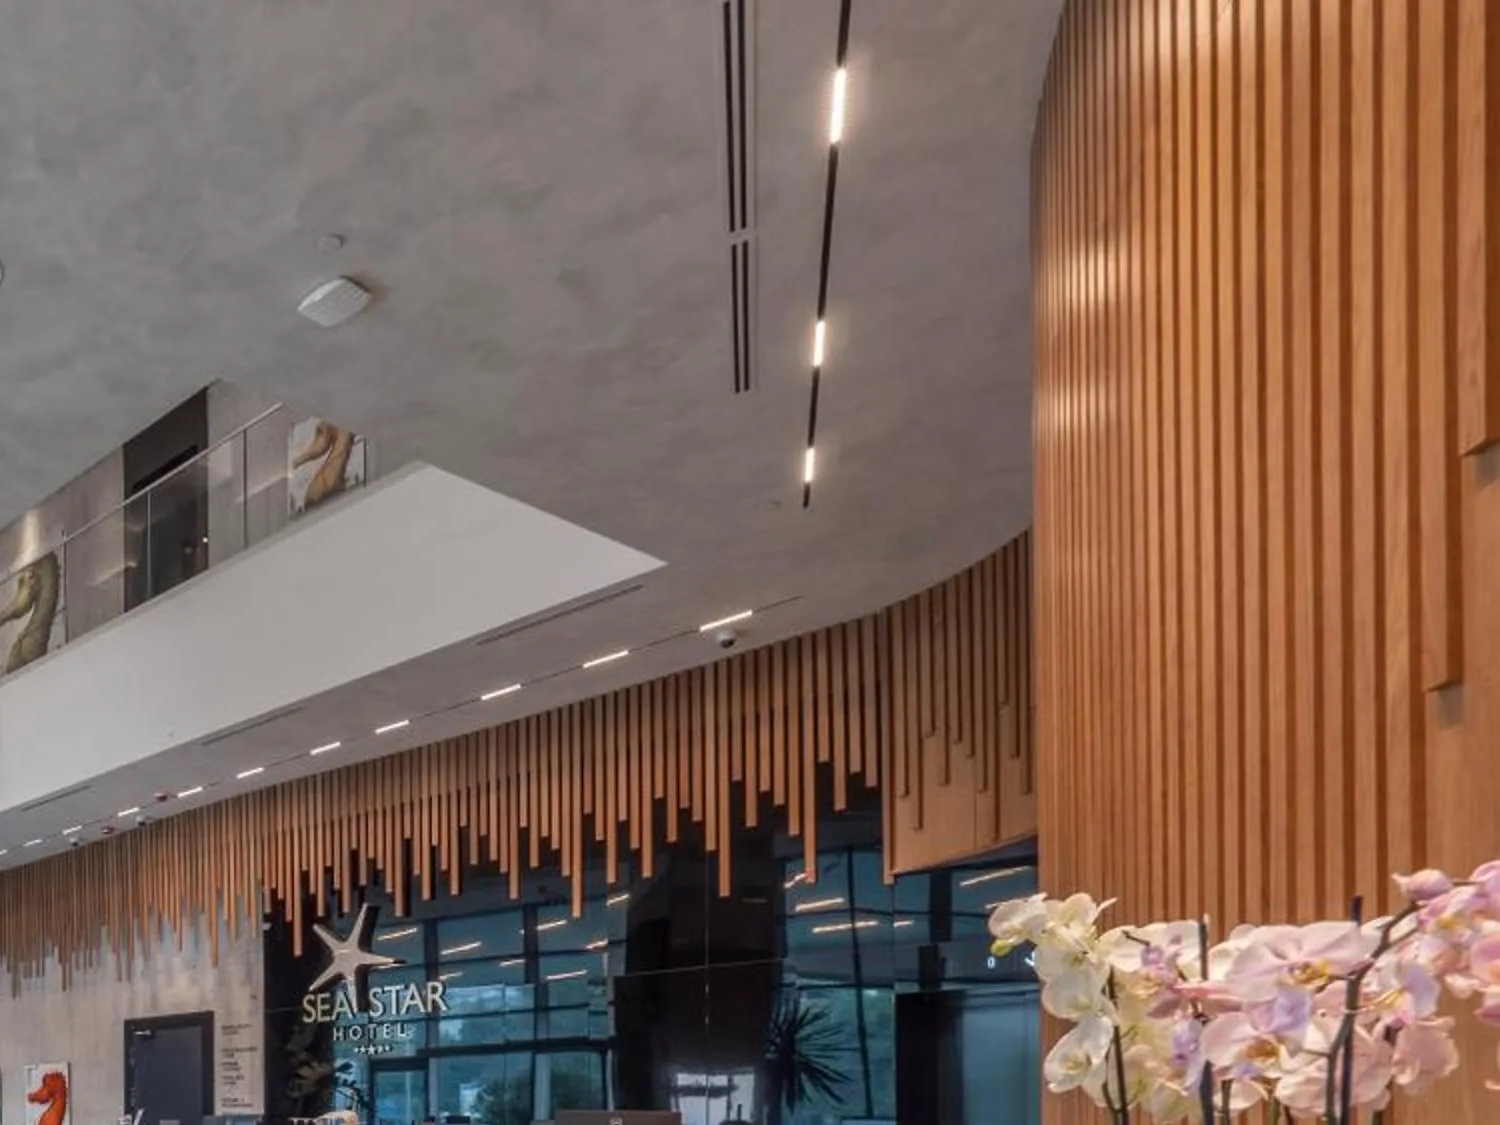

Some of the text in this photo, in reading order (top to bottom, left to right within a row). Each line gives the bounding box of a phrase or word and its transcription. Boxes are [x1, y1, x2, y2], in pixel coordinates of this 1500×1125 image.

[302, 981, 448, 1023] SEA STAR
[333, 1023, 406, 1041] HOTEL
